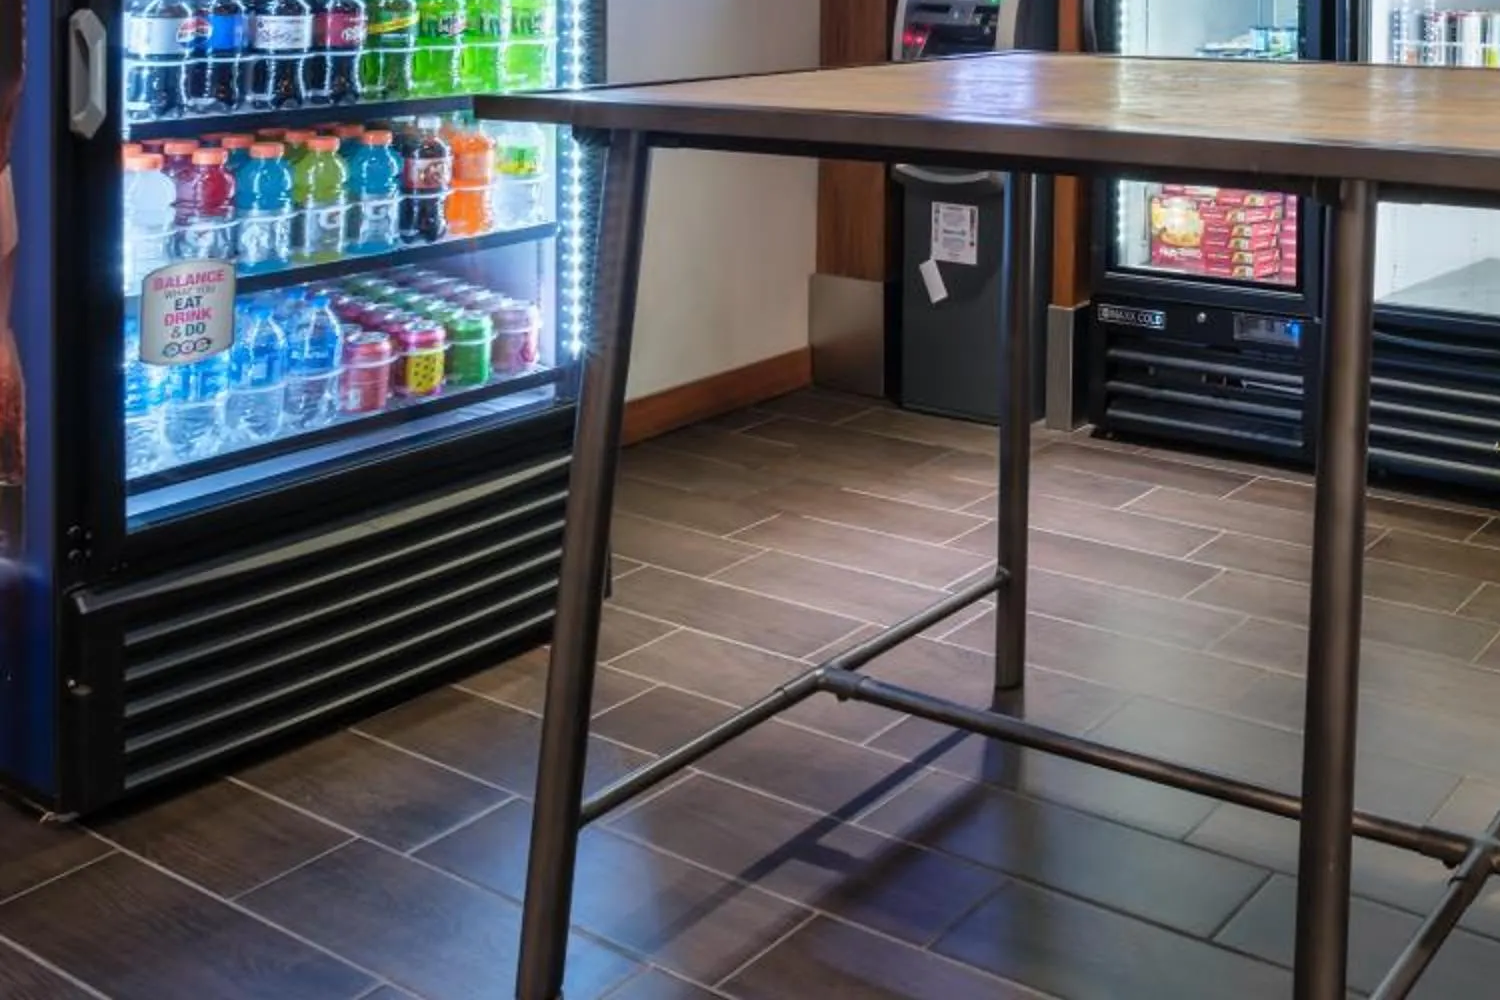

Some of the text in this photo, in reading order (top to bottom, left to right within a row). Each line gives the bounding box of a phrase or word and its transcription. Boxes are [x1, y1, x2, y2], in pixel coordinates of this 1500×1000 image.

[153, 269, 225, 291] BALANCE
[175, 295, 203, 310] EAT
[164, 307, 213, 326] DRINK
[185, 322, 206, 336] DO
